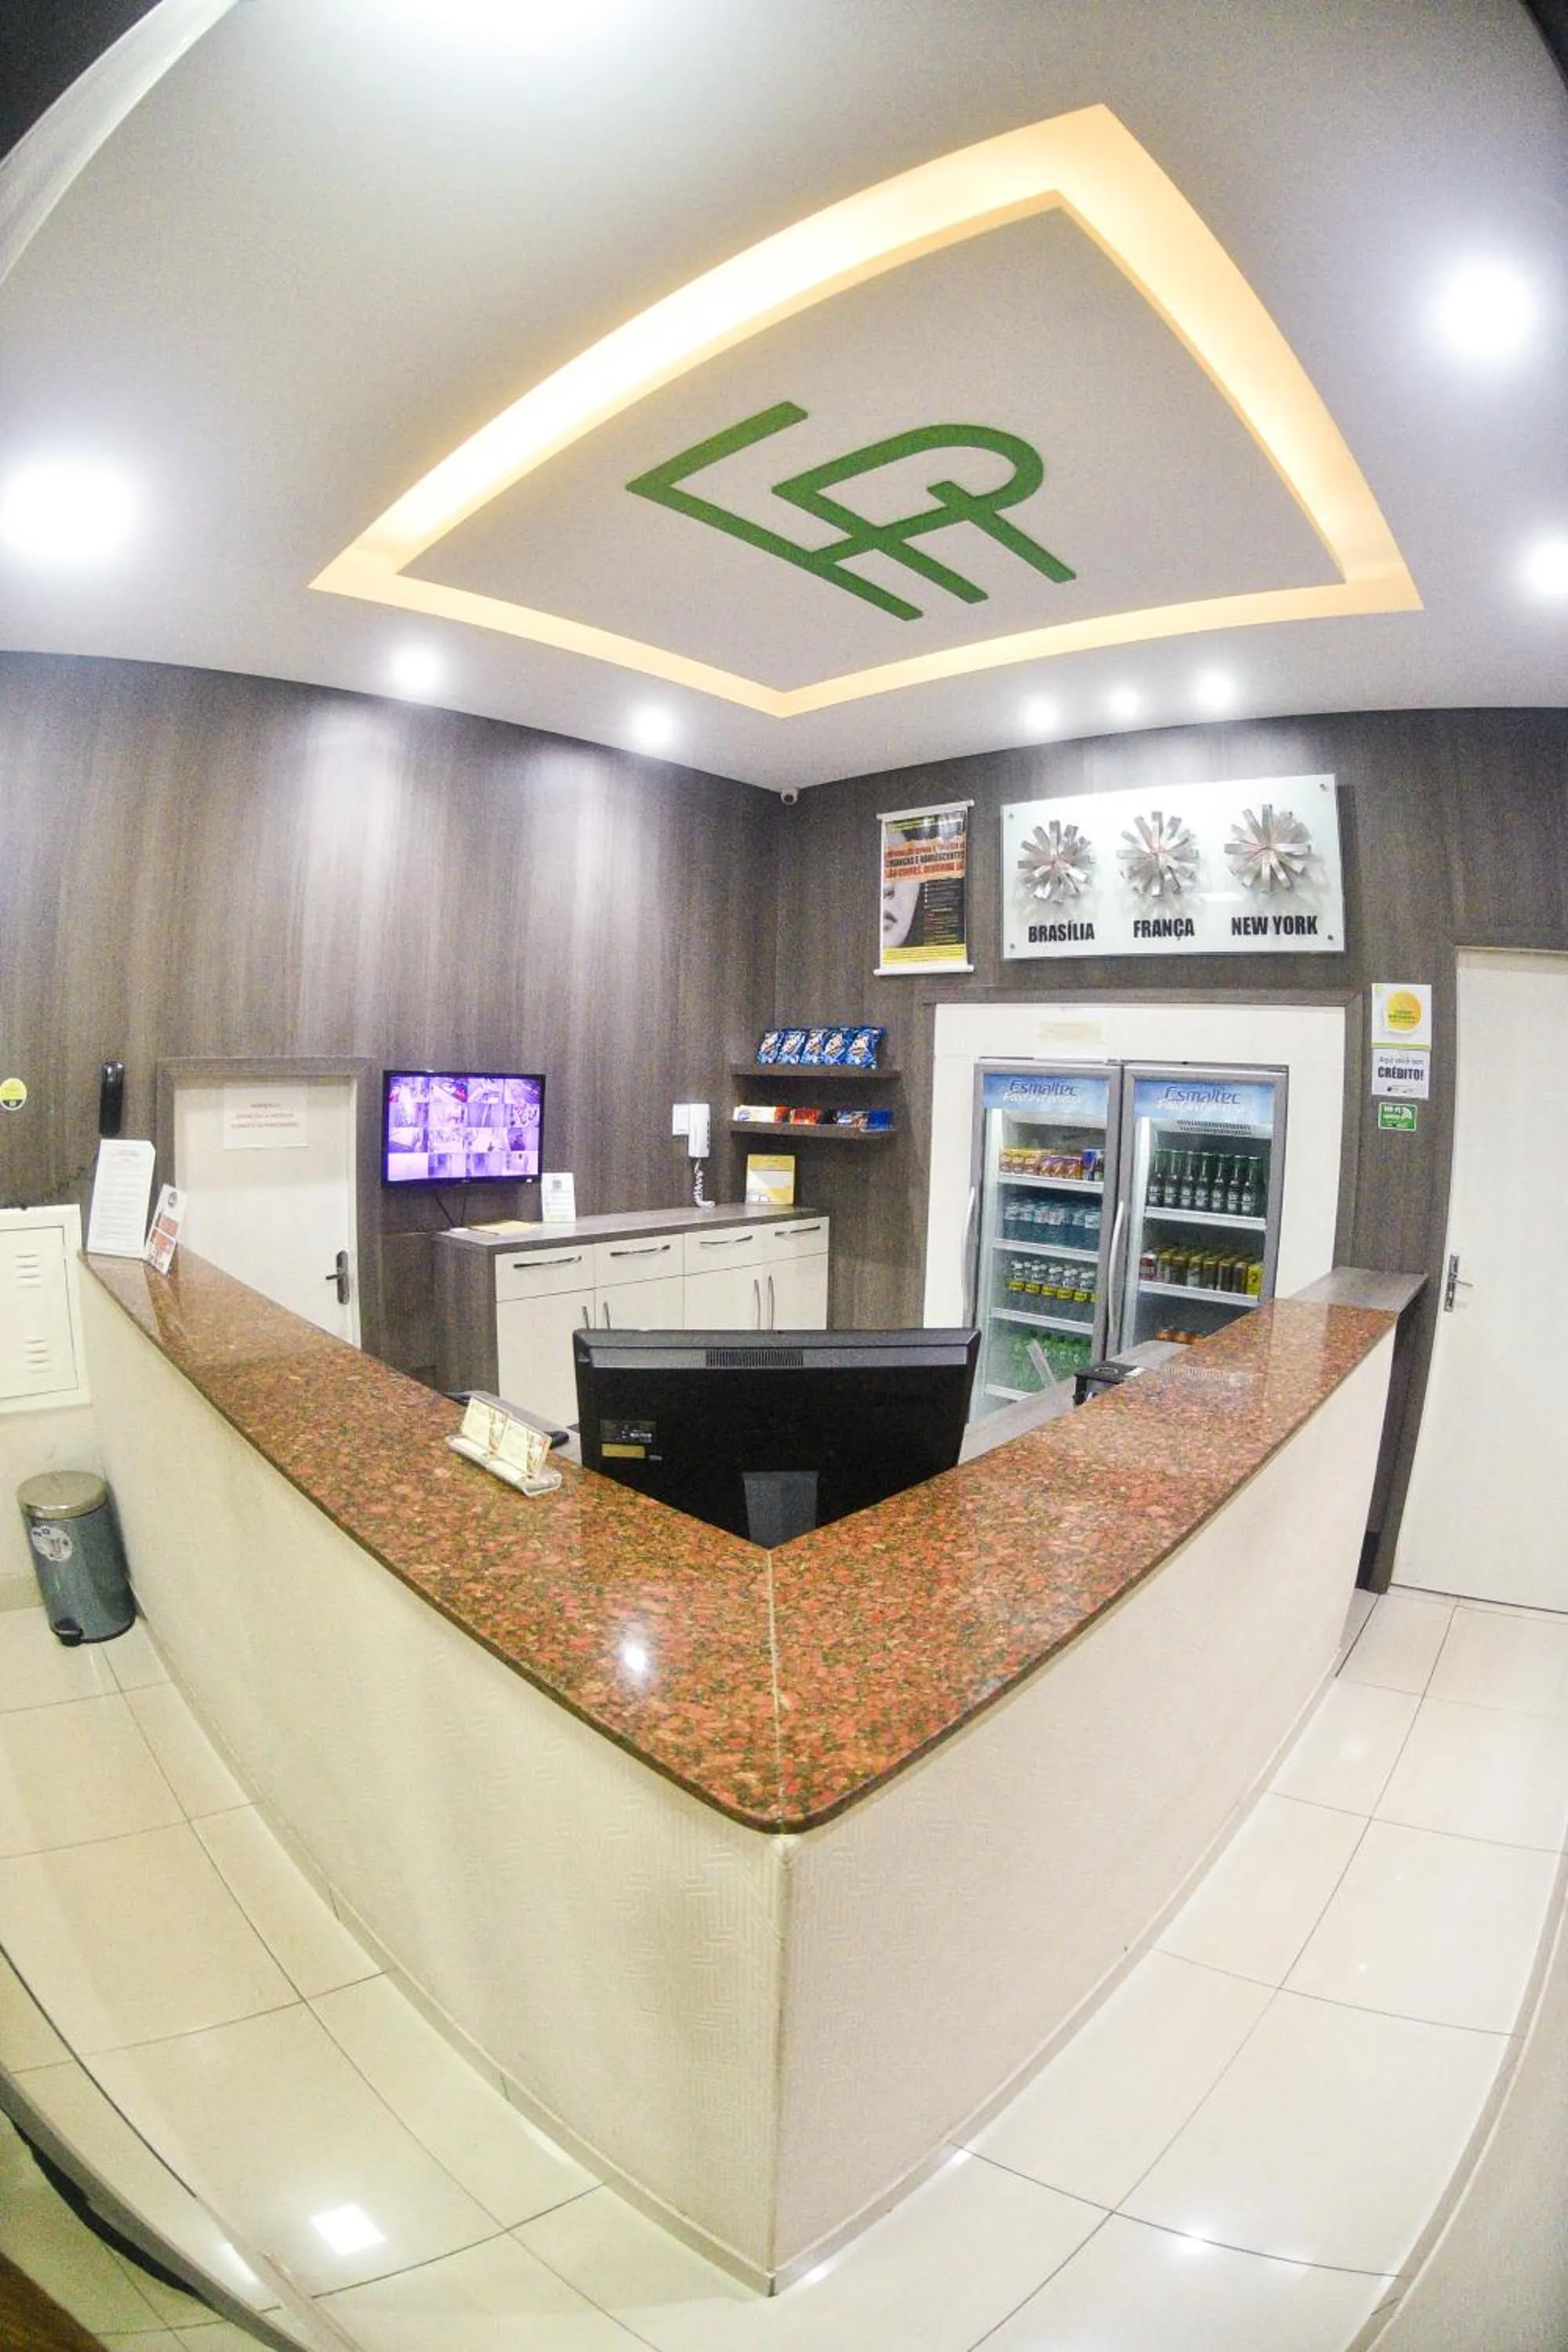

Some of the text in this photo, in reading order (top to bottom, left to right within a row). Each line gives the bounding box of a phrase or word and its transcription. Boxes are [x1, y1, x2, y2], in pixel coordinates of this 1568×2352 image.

[1029, 920, 1094, 942] BRASÍLIA
[1134, 918, 1195, 941] FRANÇA
[1232, 915, 1318, 935] NEW YORK
[1378, 1065, 1425, 1080] CRÉDITO!
[1009, 1079, 1079, 1097] Esmaltec
[1164, 1086, 1241, 1105] Esmaltec
